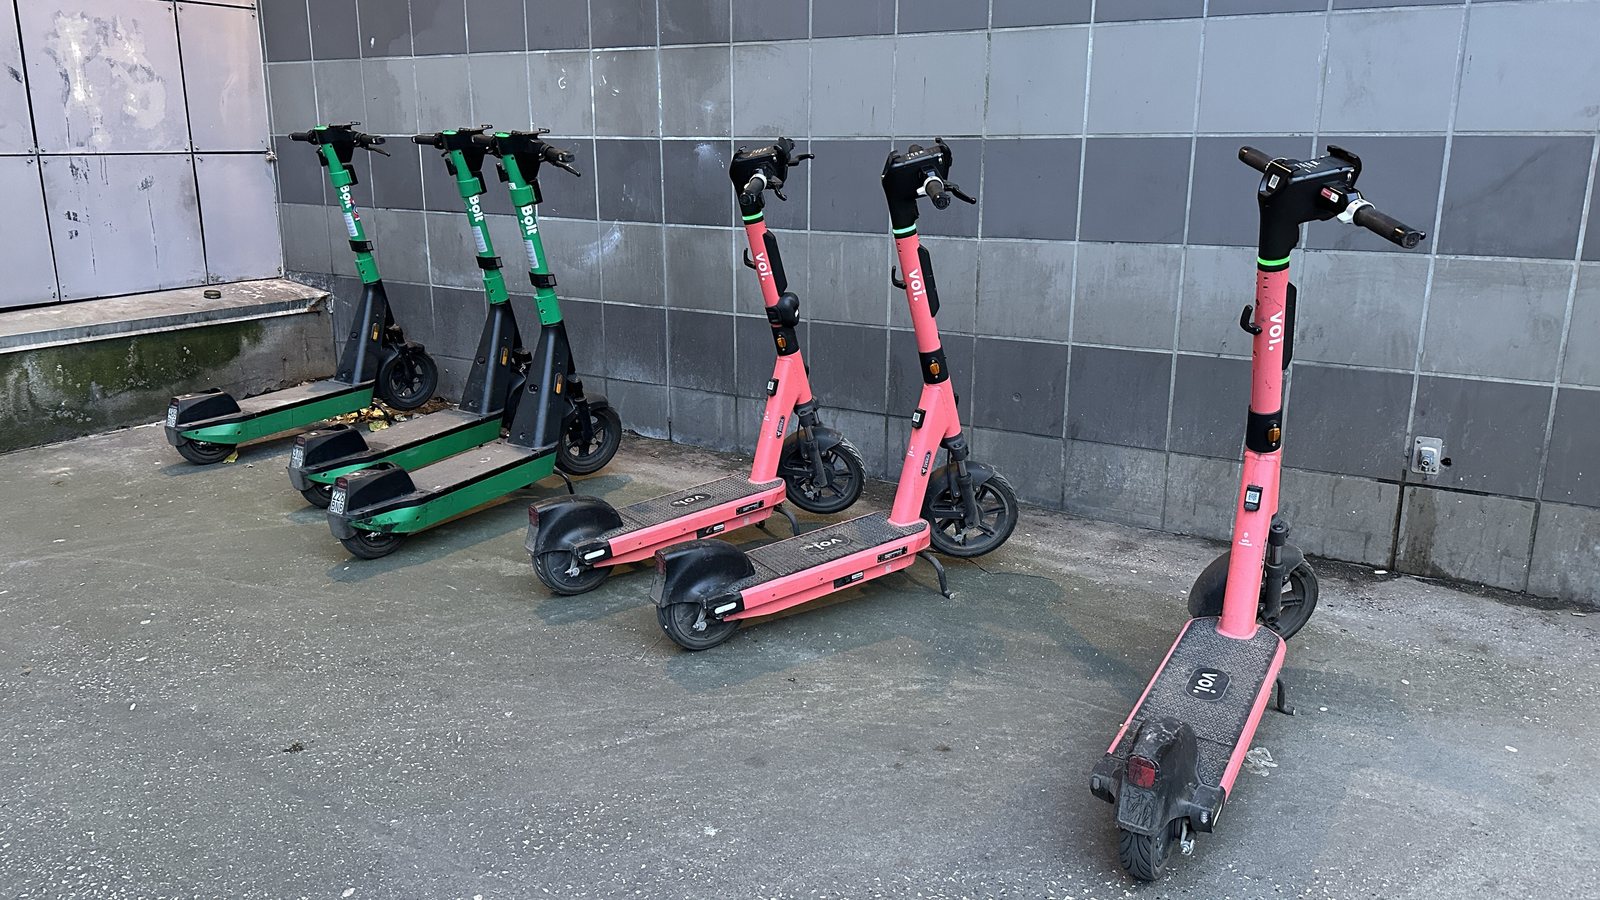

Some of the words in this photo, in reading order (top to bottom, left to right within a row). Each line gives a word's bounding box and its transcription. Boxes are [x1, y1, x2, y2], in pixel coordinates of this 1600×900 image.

[468, 195, 484, 223] Bolt
[521, 204, 538, 236] Bolt
[755, 252, 773, 281] voi.
[908, 268, 926, 302] voi.
[1268, 310, 1284, 351] voi.
[1192, 673, 1218, 694] voi.
